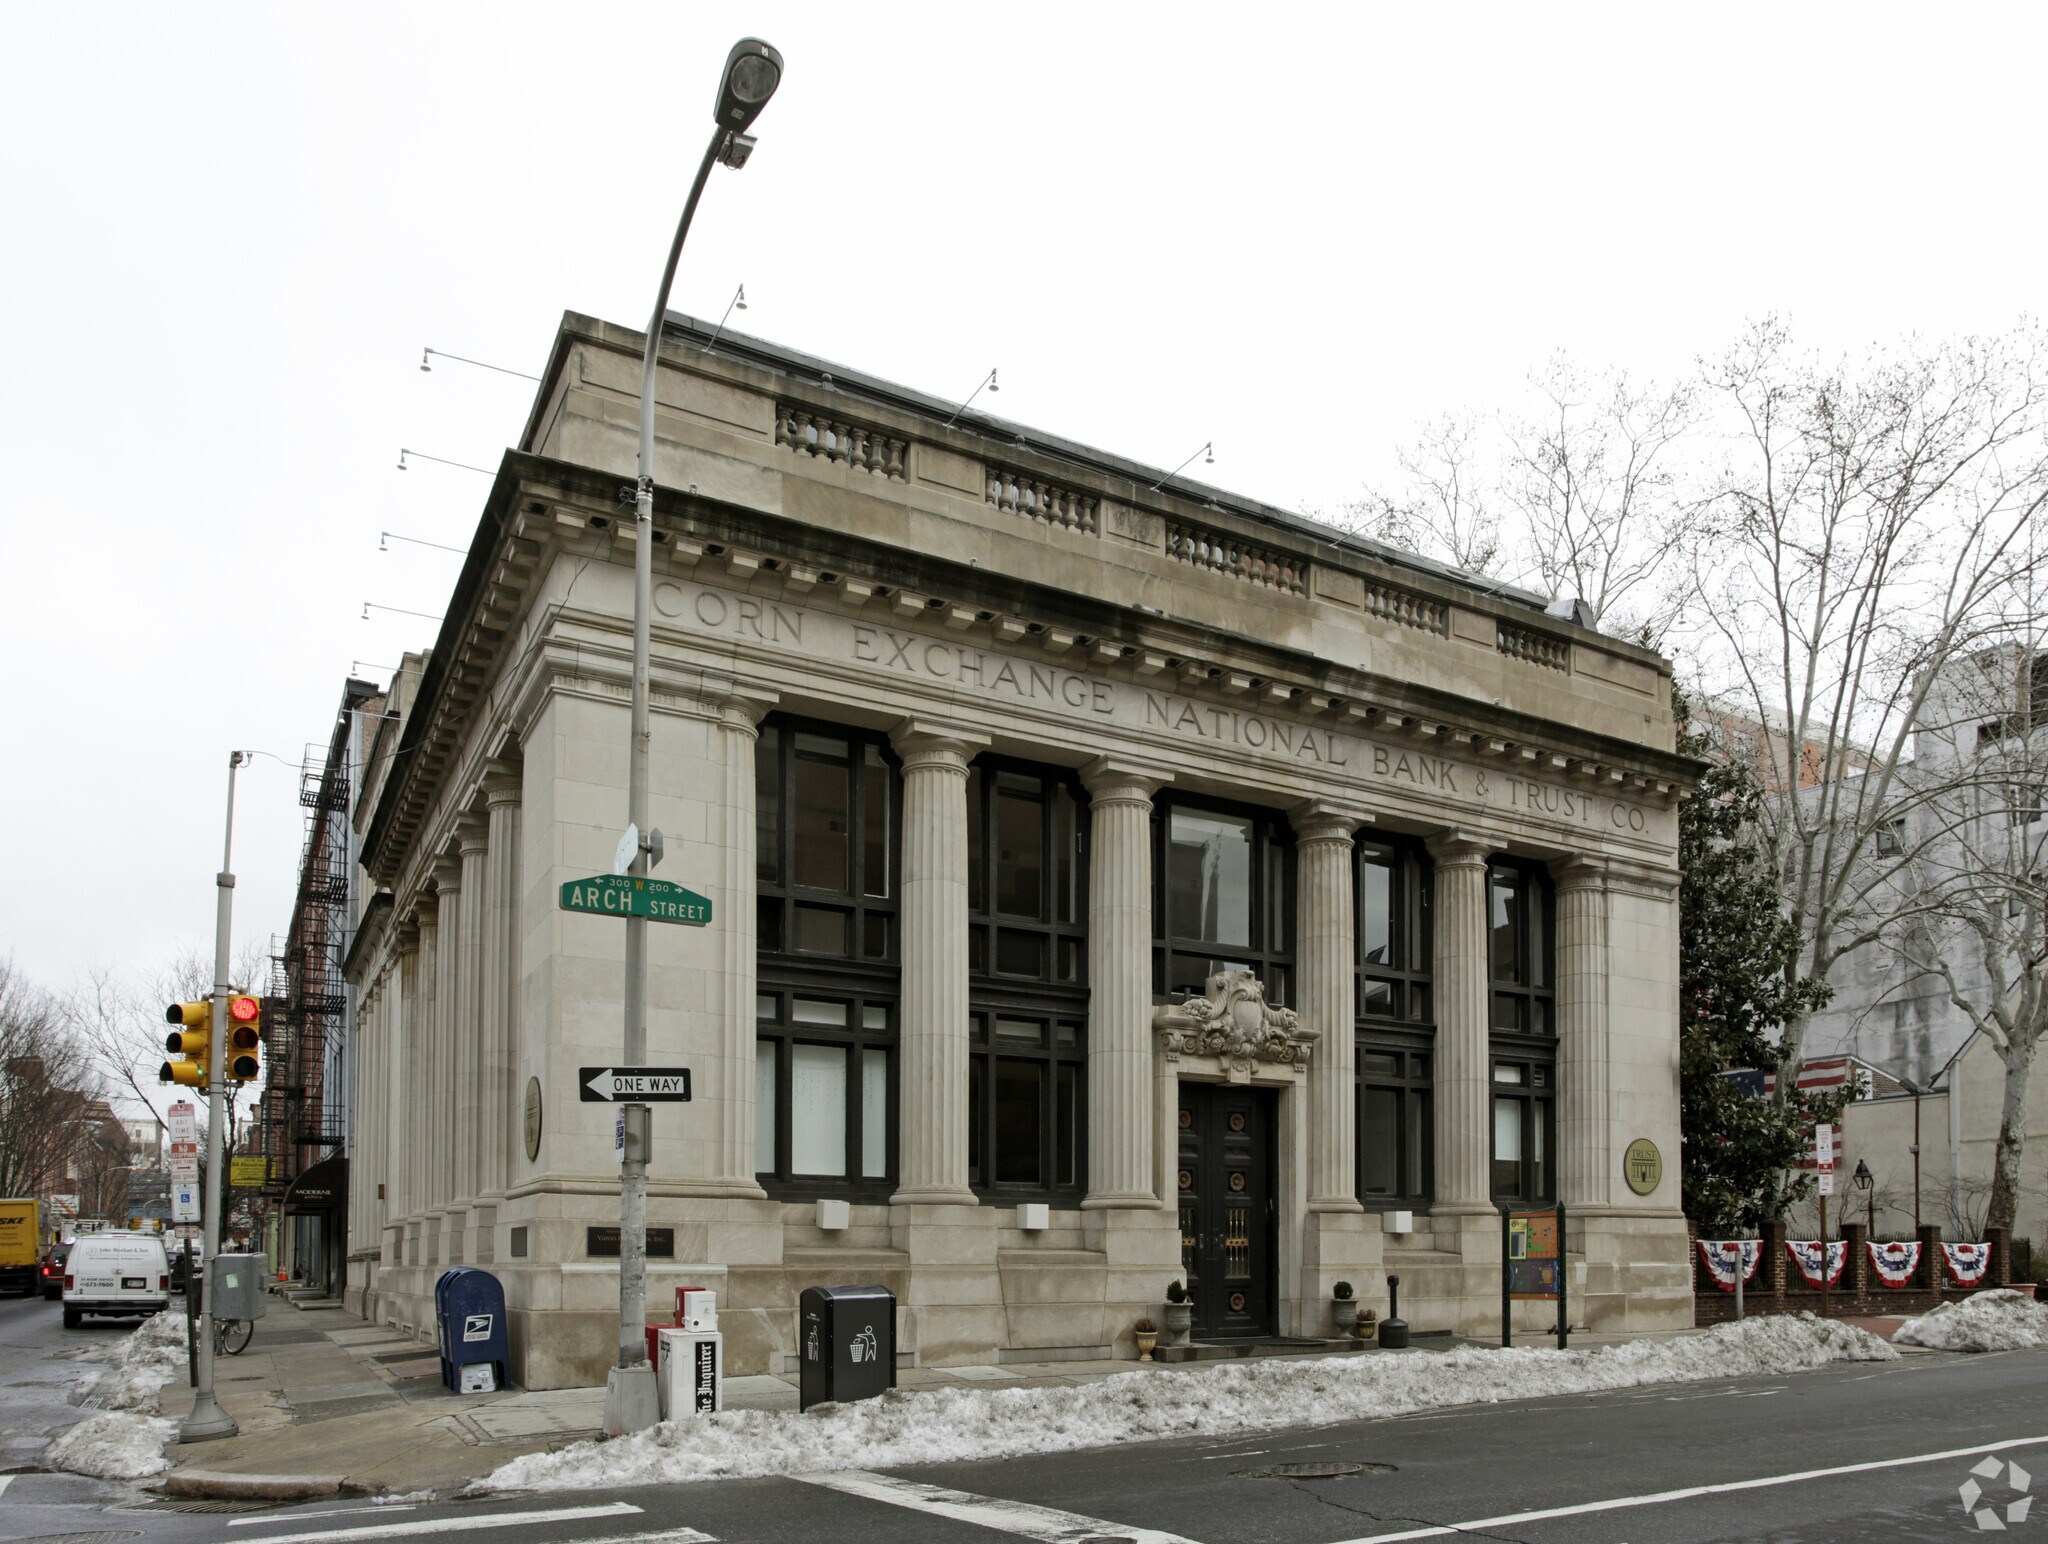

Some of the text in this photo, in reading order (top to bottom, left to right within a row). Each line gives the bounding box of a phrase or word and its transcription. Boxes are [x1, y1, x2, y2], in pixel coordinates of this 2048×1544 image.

[652, 582, 1650, 835] CORN EXCHANGE NATIONAL BANK & TRUST CO.
[609, 878, 670, 893] 300 W 200
[570, 886, 705, 920] ARCH STREET
[613, 1077, 681, 1093] ONE WAY
[178, 1144, 188, 1153] NO
[1631, 1149, 1657, 1159] TRUST
[696, 1343, 715, 1397] Inquirer
